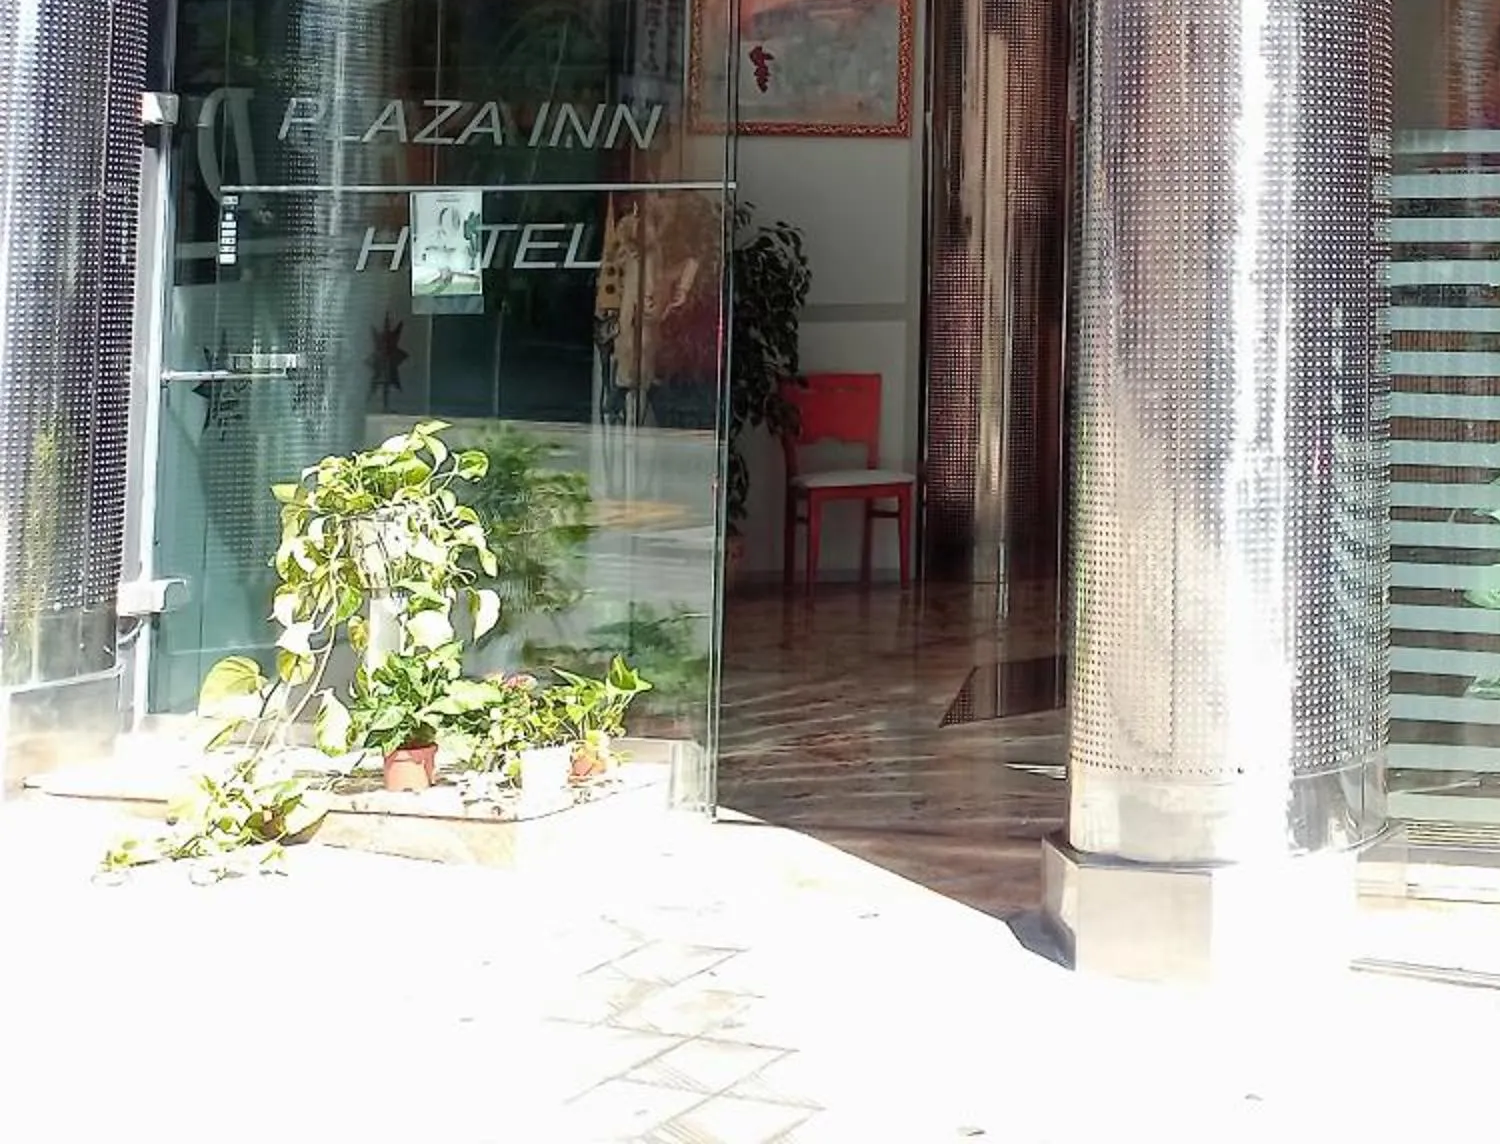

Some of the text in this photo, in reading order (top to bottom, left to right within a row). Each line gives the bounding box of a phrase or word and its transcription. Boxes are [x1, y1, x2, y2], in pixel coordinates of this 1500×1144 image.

[278, 97, 663, 150] PLAZA INN
[354, 222, 604, 272] HTEL
